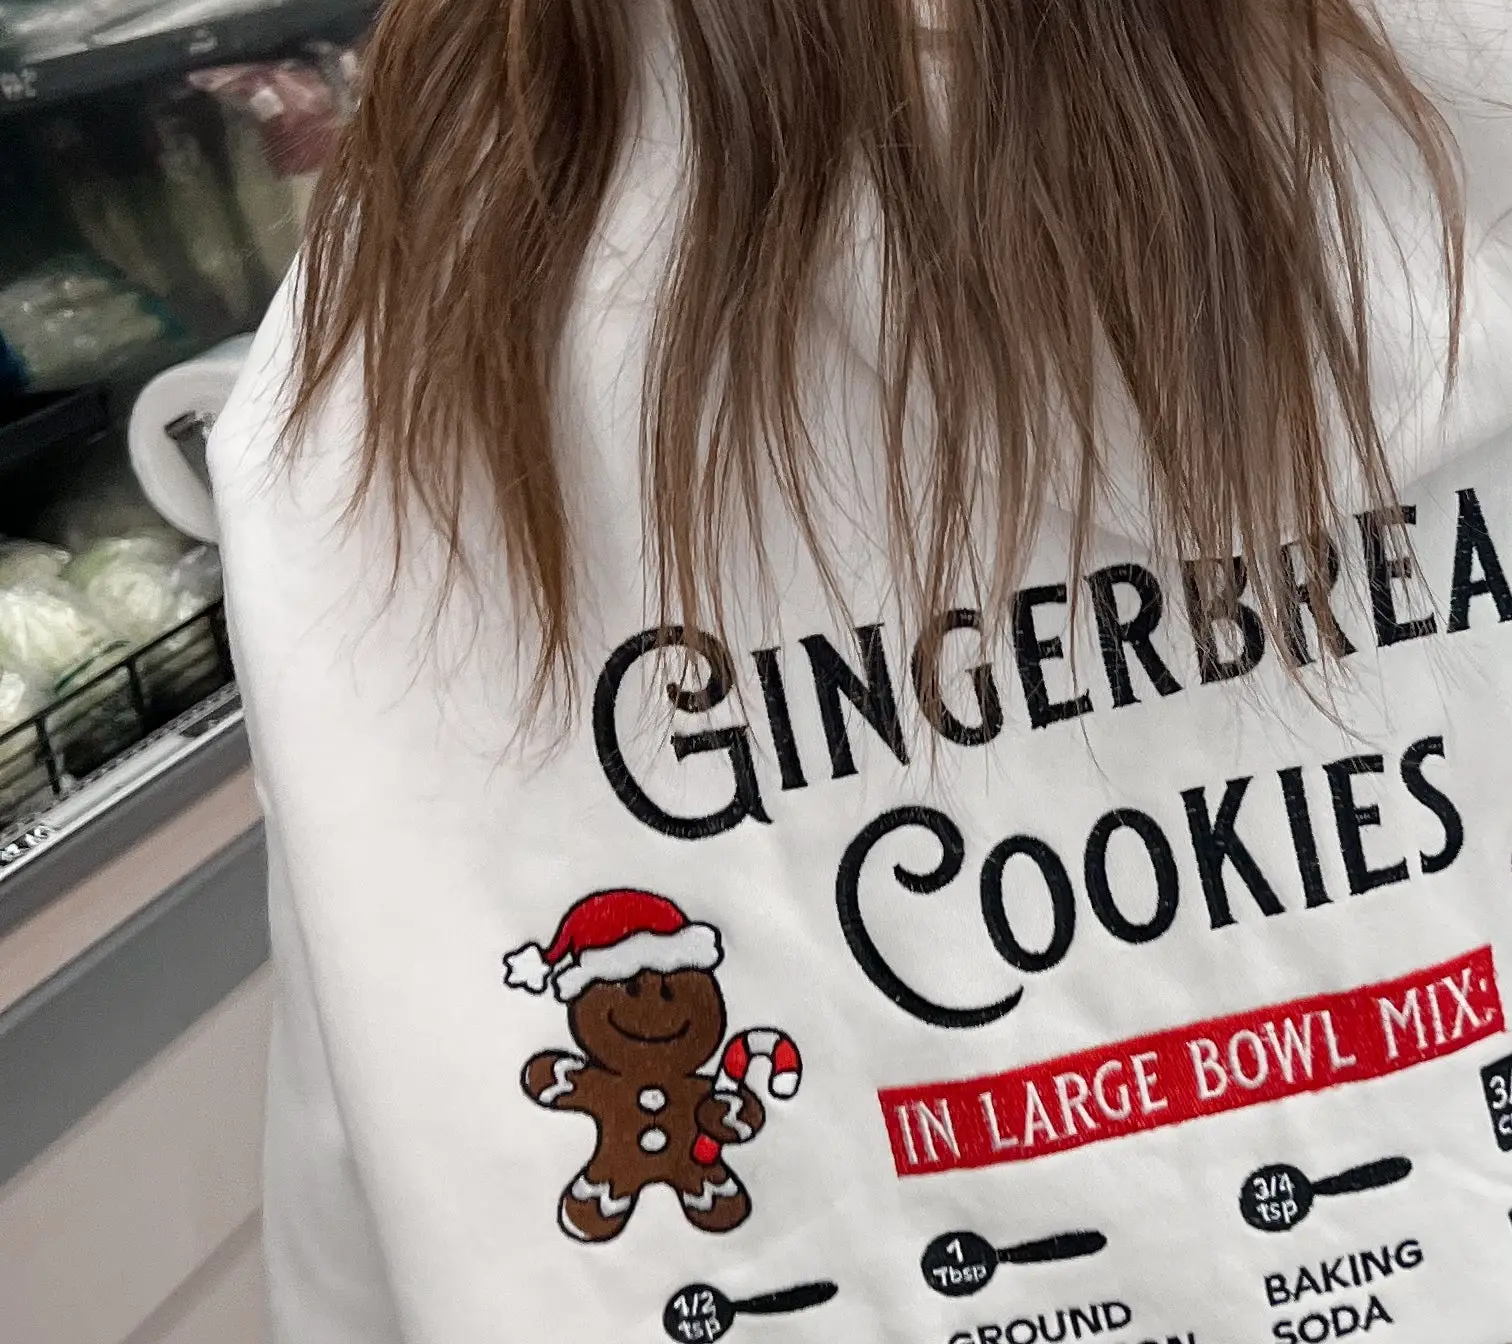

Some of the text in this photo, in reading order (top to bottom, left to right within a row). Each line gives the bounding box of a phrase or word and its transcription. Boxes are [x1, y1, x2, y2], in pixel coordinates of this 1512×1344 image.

[836, 736, 1464, 1028] COOKIES
[897, 1097, 961, 1165] IN
[980, 1051, 1168, 1152] LARGE
[1186, 1009, 1356, 1099] BOWL
[1253, 1173, 1296, 1201] 3/4
[1257, 1198, 1298, 1225] tsp
[946, 1239, 964, 1263] 1
[931, 1262, 988, 1287] Tbsp
[1263, 1238, 1425, 1308] BAKING
[672, 1290, 716, 1317] 1/2
